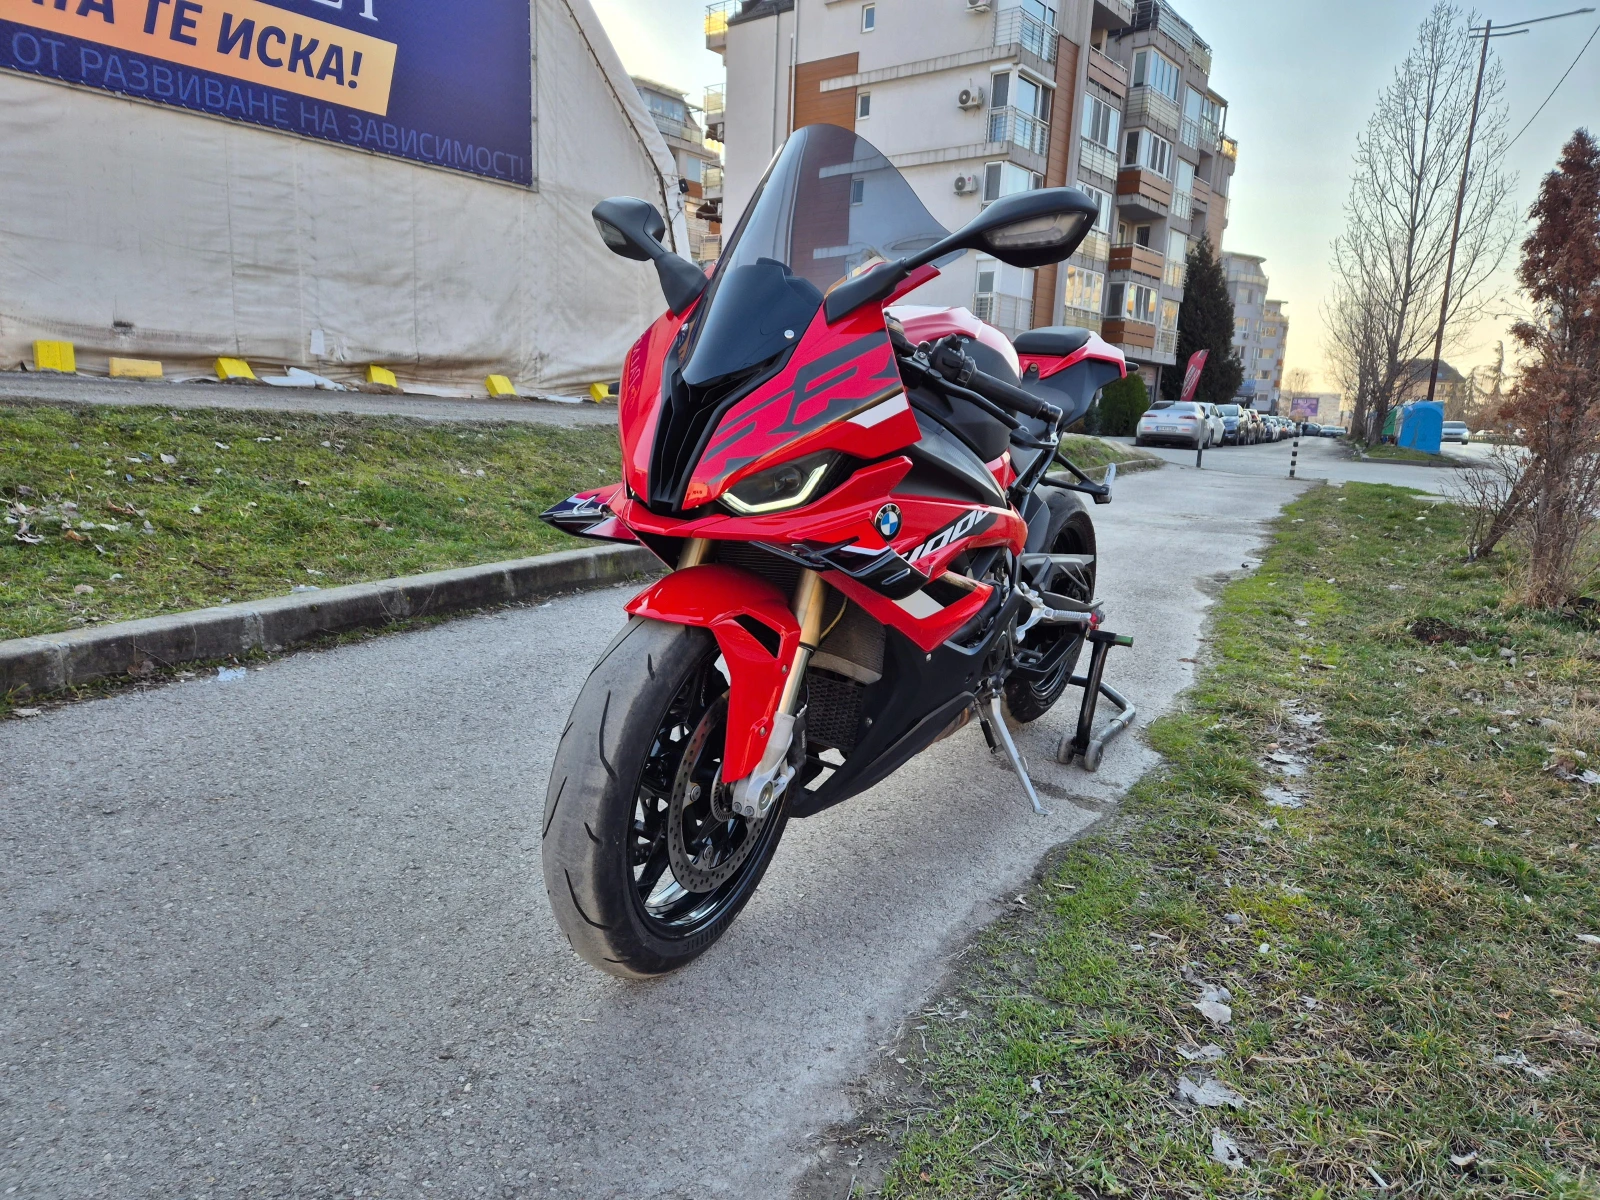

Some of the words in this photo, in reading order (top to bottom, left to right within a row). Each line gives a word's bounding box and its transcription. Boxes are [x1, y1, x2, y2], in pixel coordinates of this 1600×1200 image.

[143, 0, 203, 46] ТЕ
[217, 12, 363, 89] ИСКА!
[12, 32, 65, 71] ОТ
[80, 47, 289, 124] РАЗВИВАНЕ
[300, 101, 340, 136] НА
[347, 114, 524, 178] ЗАВИСИМОСТ!
